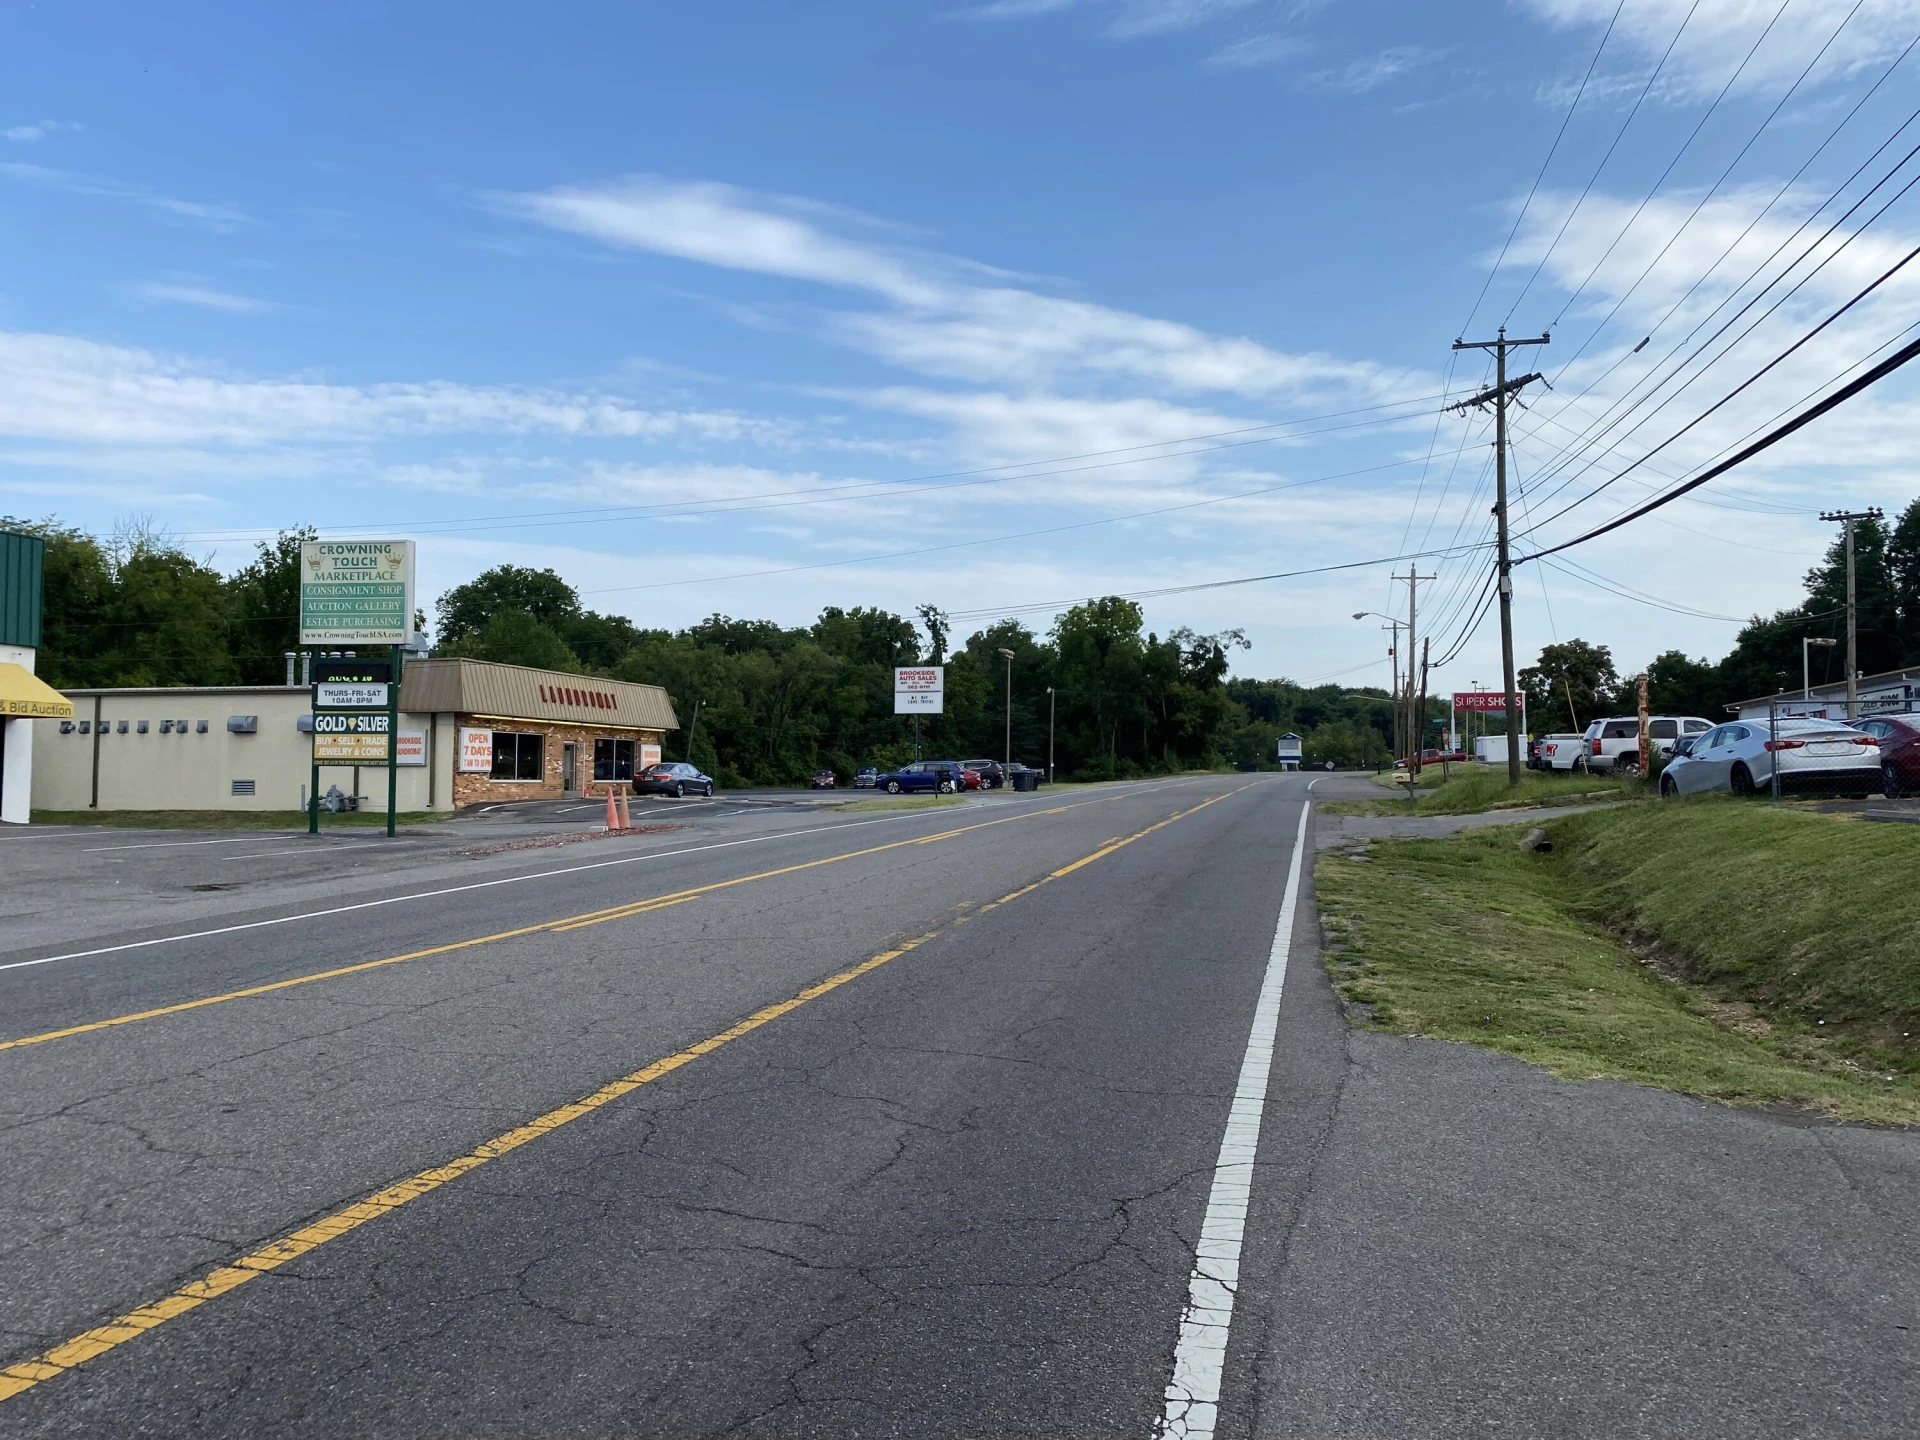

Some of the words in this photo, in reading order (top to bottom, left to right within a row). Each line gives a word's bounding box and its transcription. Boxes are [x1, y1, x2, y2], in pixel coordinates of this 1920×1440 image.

[319, 544, 392, 555] CROWNING
[332, 557, 378, 566] TOUCH
[314, 571, 396, 581] MARKETPLACE
[306, 586, 376, 594] CONSIGNMENT
[378, 586, 402, 594] SHOP
[307, 602, 352, 610] AUCTION
[355, 602, 401, 610] GALLERY
[306, 618, 340, 626] ESTATE
[342, 617, 400, 626] PURCHASING
[540, 684, 617, 710] LAUNDROMAT
[1456, 696, 1485, 706] SUPER
[1488, 696, 1522, 706] SHOS
[10, 702, 28, 712] Bid
[30, 704, 71, 716] Auction
[316, 716, 346, 731] GOLD
[358, 716, 389, 732] SILVER
[468, 734, 488, 743] OPEN
[464, 746, 469, 755] 7
[470, 746, 492, 756] DAYS
